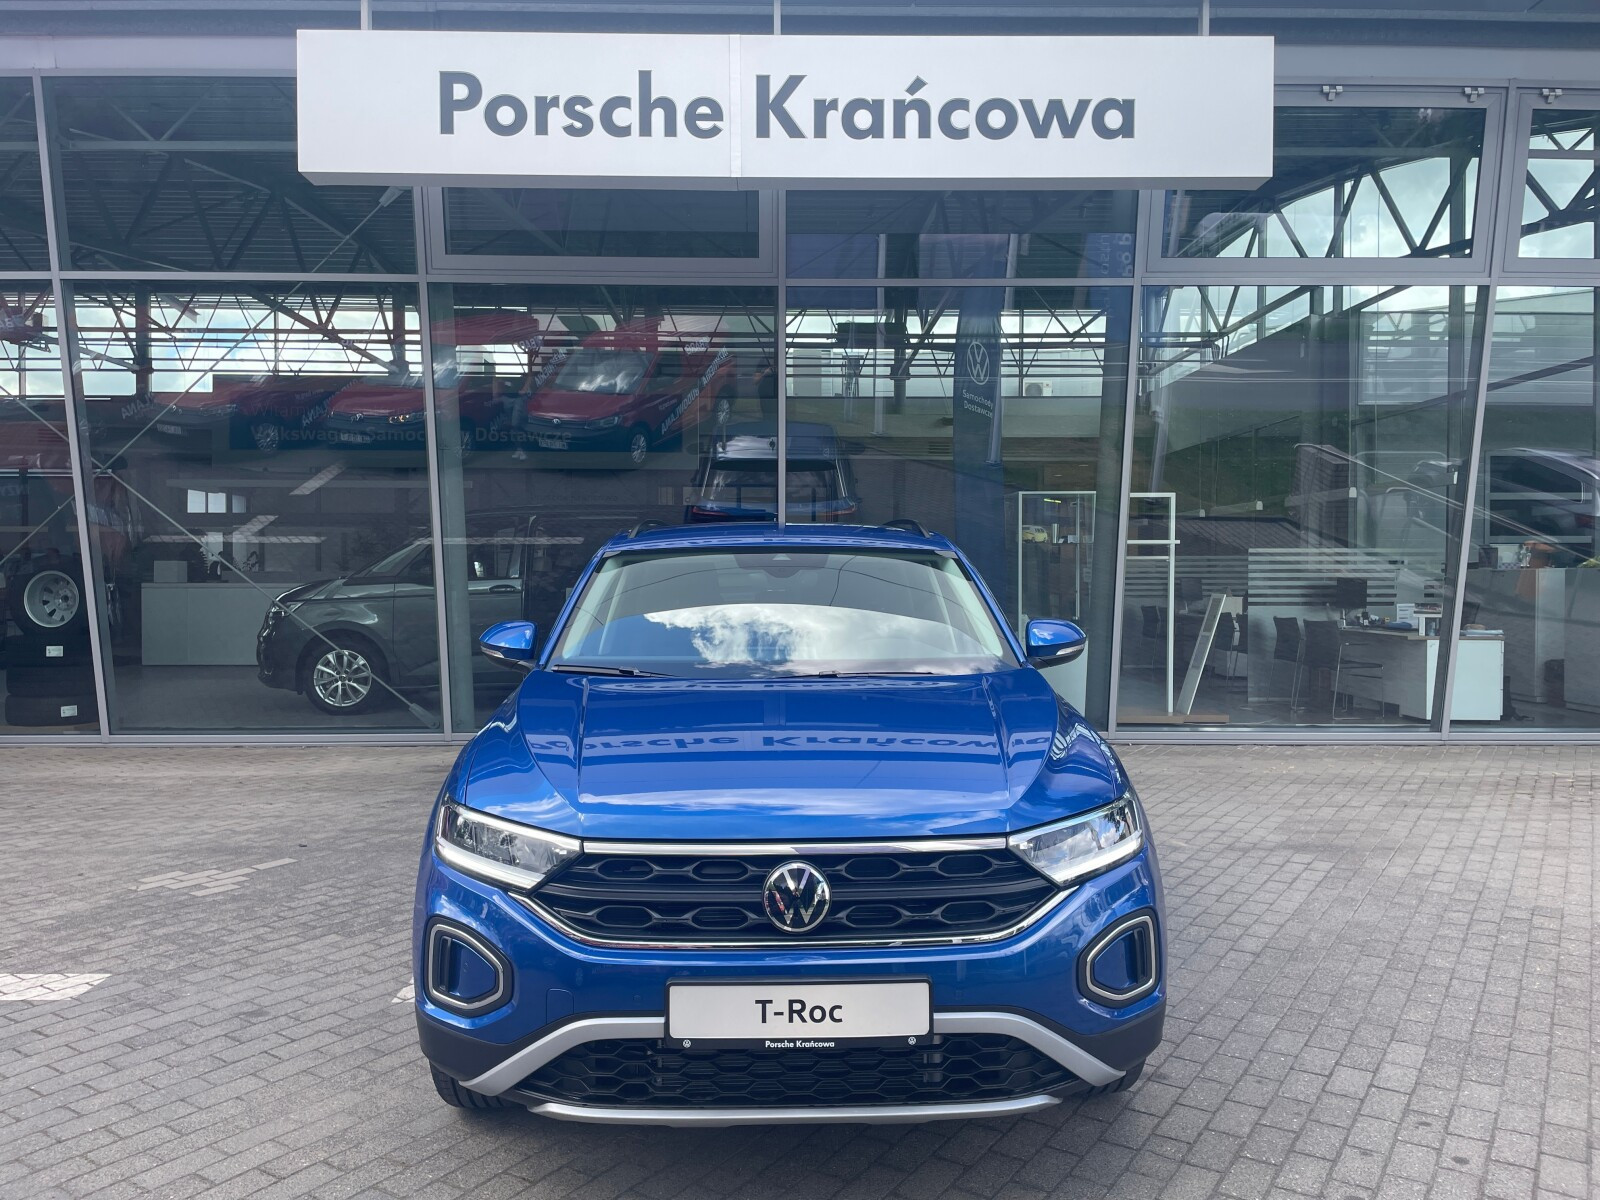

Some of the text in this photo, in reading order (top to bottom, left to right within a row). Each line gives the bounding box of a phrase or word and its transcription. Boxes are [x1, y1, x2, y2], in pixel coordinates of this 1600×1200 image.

[439, 70, 1136, 141] Porsche Krańcowa
[962, 389, 994, 410] Samochody
[250, 426, 359, 444] Vkswag
[475, 427, 572, 442] Dostawcze
[754, 999, 843, 1024] T-Roc
[765, 1039, 835, 1049] Porsche Krańcowa
